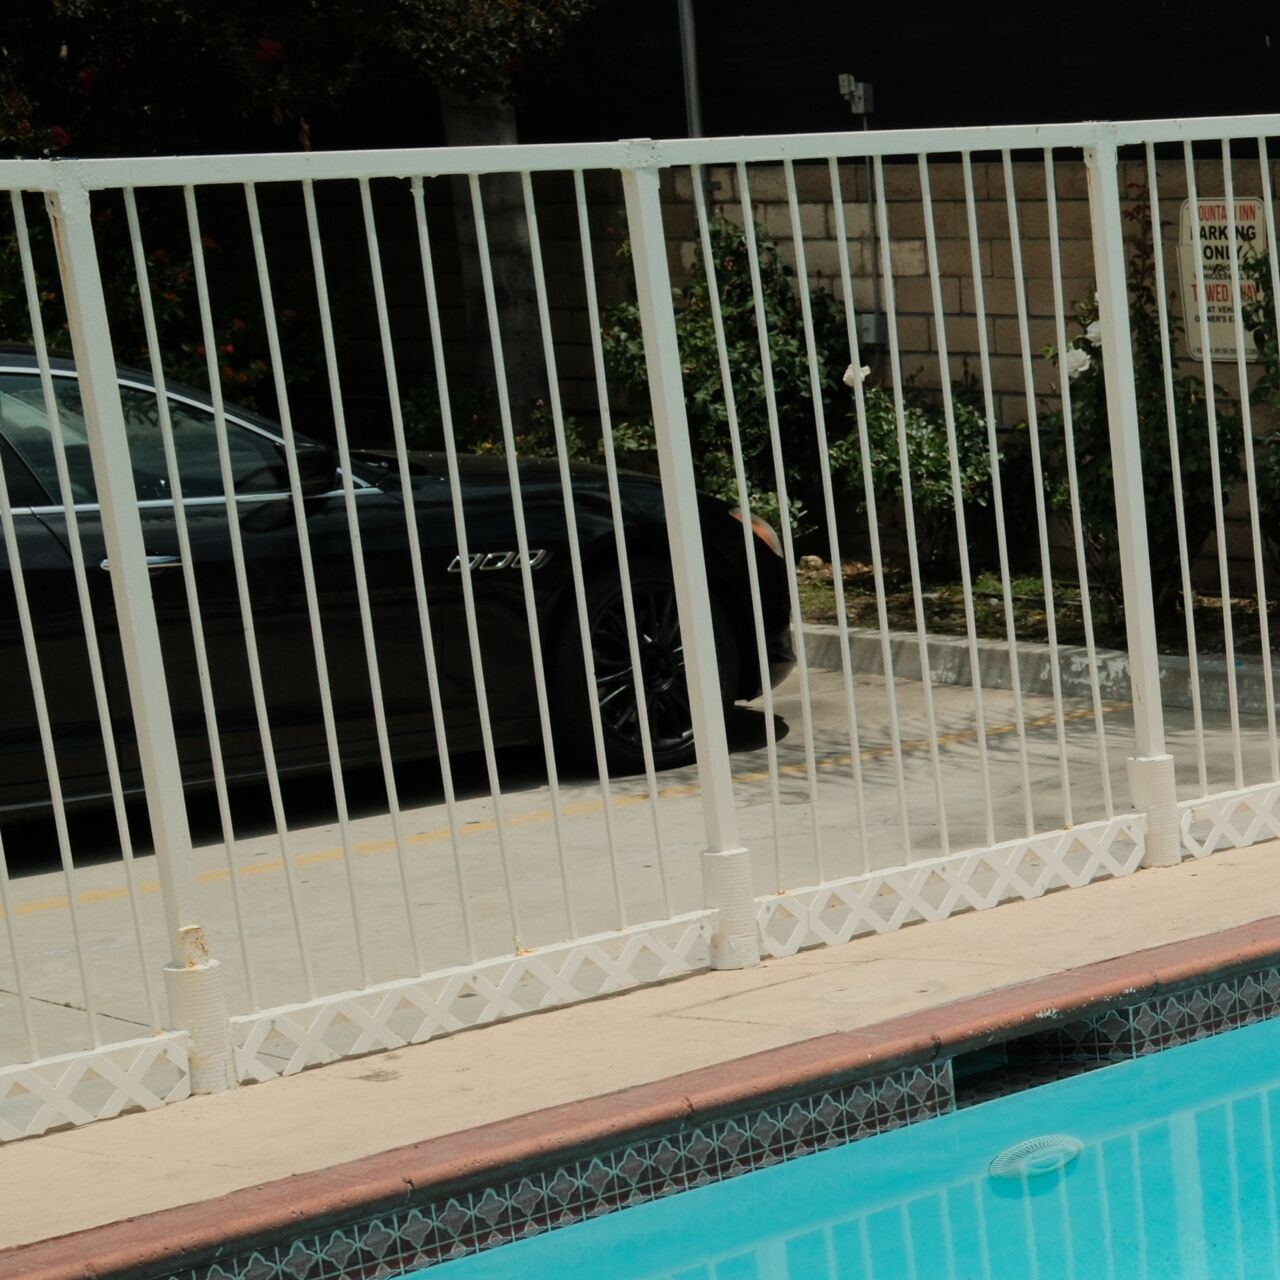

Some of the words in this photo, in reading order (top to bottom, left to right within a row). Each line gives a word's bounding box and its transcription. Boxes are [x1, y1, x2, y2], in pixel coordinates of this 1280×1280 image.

[1239, 205, 1256, 220] INN
[1190, 225, 1256, 240] ARKNG
[1192, 284, 1228, 302] TWED
